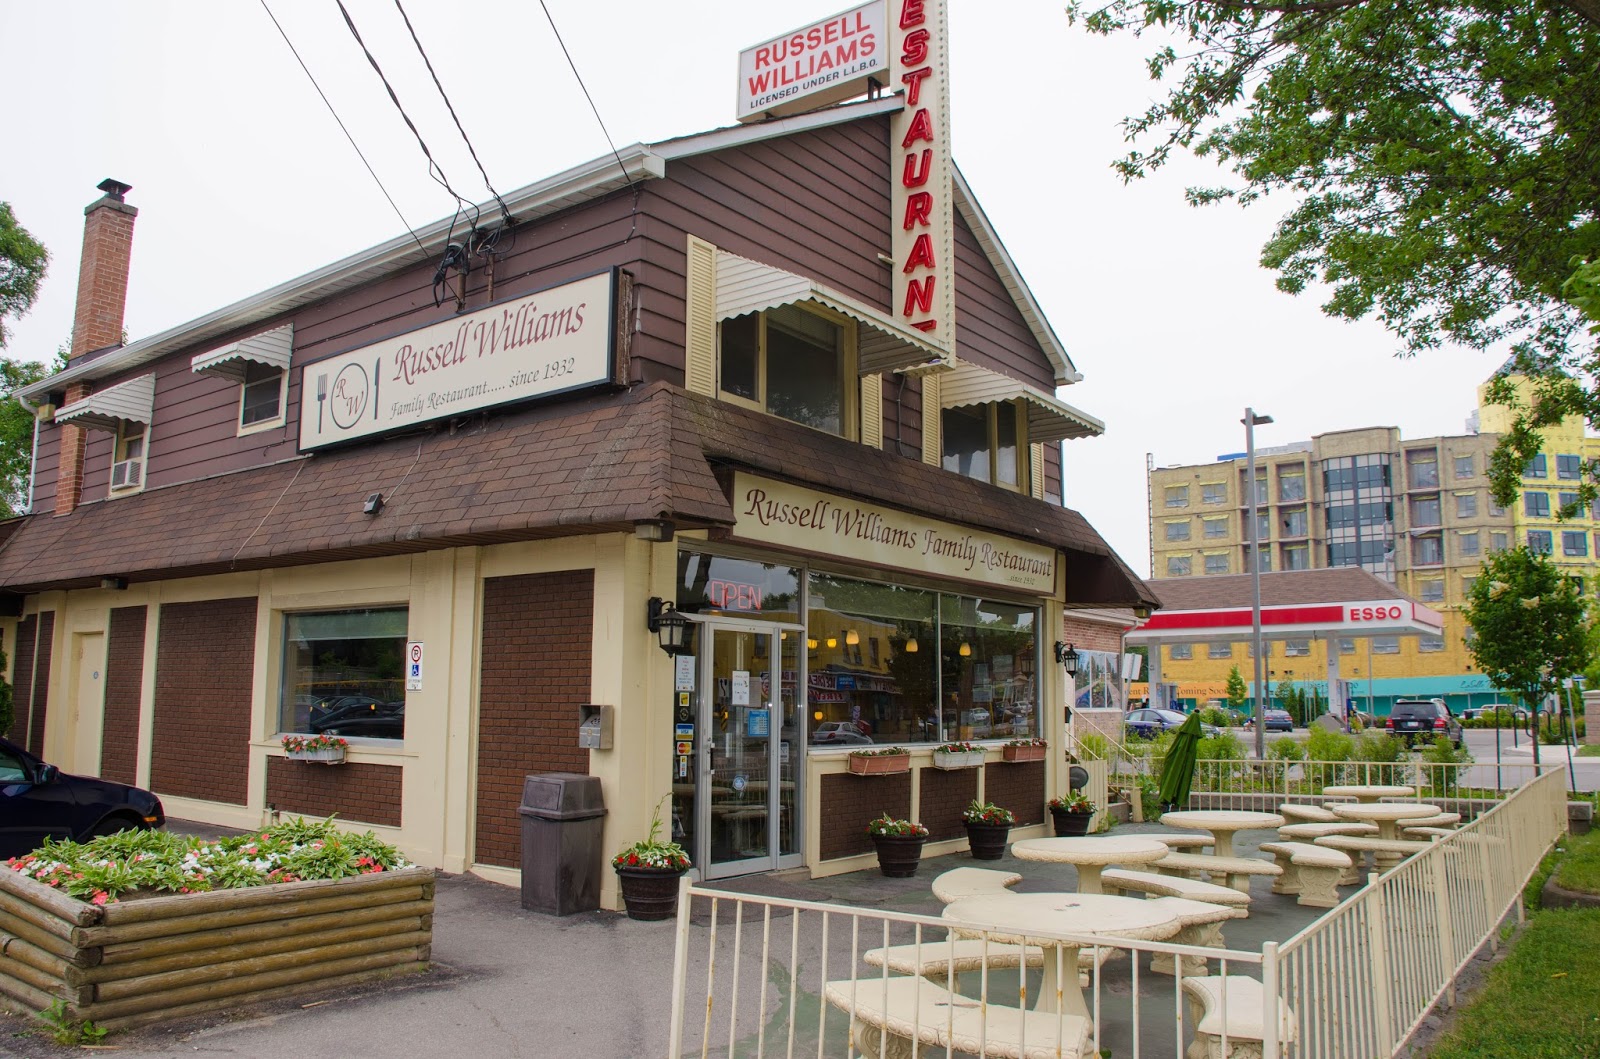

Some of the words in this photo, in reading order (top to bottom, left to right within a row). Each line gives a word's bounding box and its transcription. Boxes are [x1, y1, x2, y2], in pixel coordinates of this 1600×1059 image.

[748, 33, 876, 96] WILLIAMS
[755, 11, 870, 70] RUSSELL
[750, 86, 799, 109] LICENSED
[802, 71, 840, 90] UNDER
[843, 58, 878, 76] L.L.B.O.
[392, 319, 474, 385] Russell
[473, 301, 587, 358] Williams
[335, 378, 348, 400] R
[346, 390, 364, 417] W
[390, 394, 425, 421] Family
[508, 366, 540, 388] since
[542, 357, 575, 380] 1932
[743, 488, 831, 530] Russell
[831, 508, 917, 549] Williams
[923, 529, 977, 571] Family
[979, 542, 1053, 577] Restaurant
[711, 580, 762, 610] OPEN
[1350, 606, 1402, 621] ESSO
